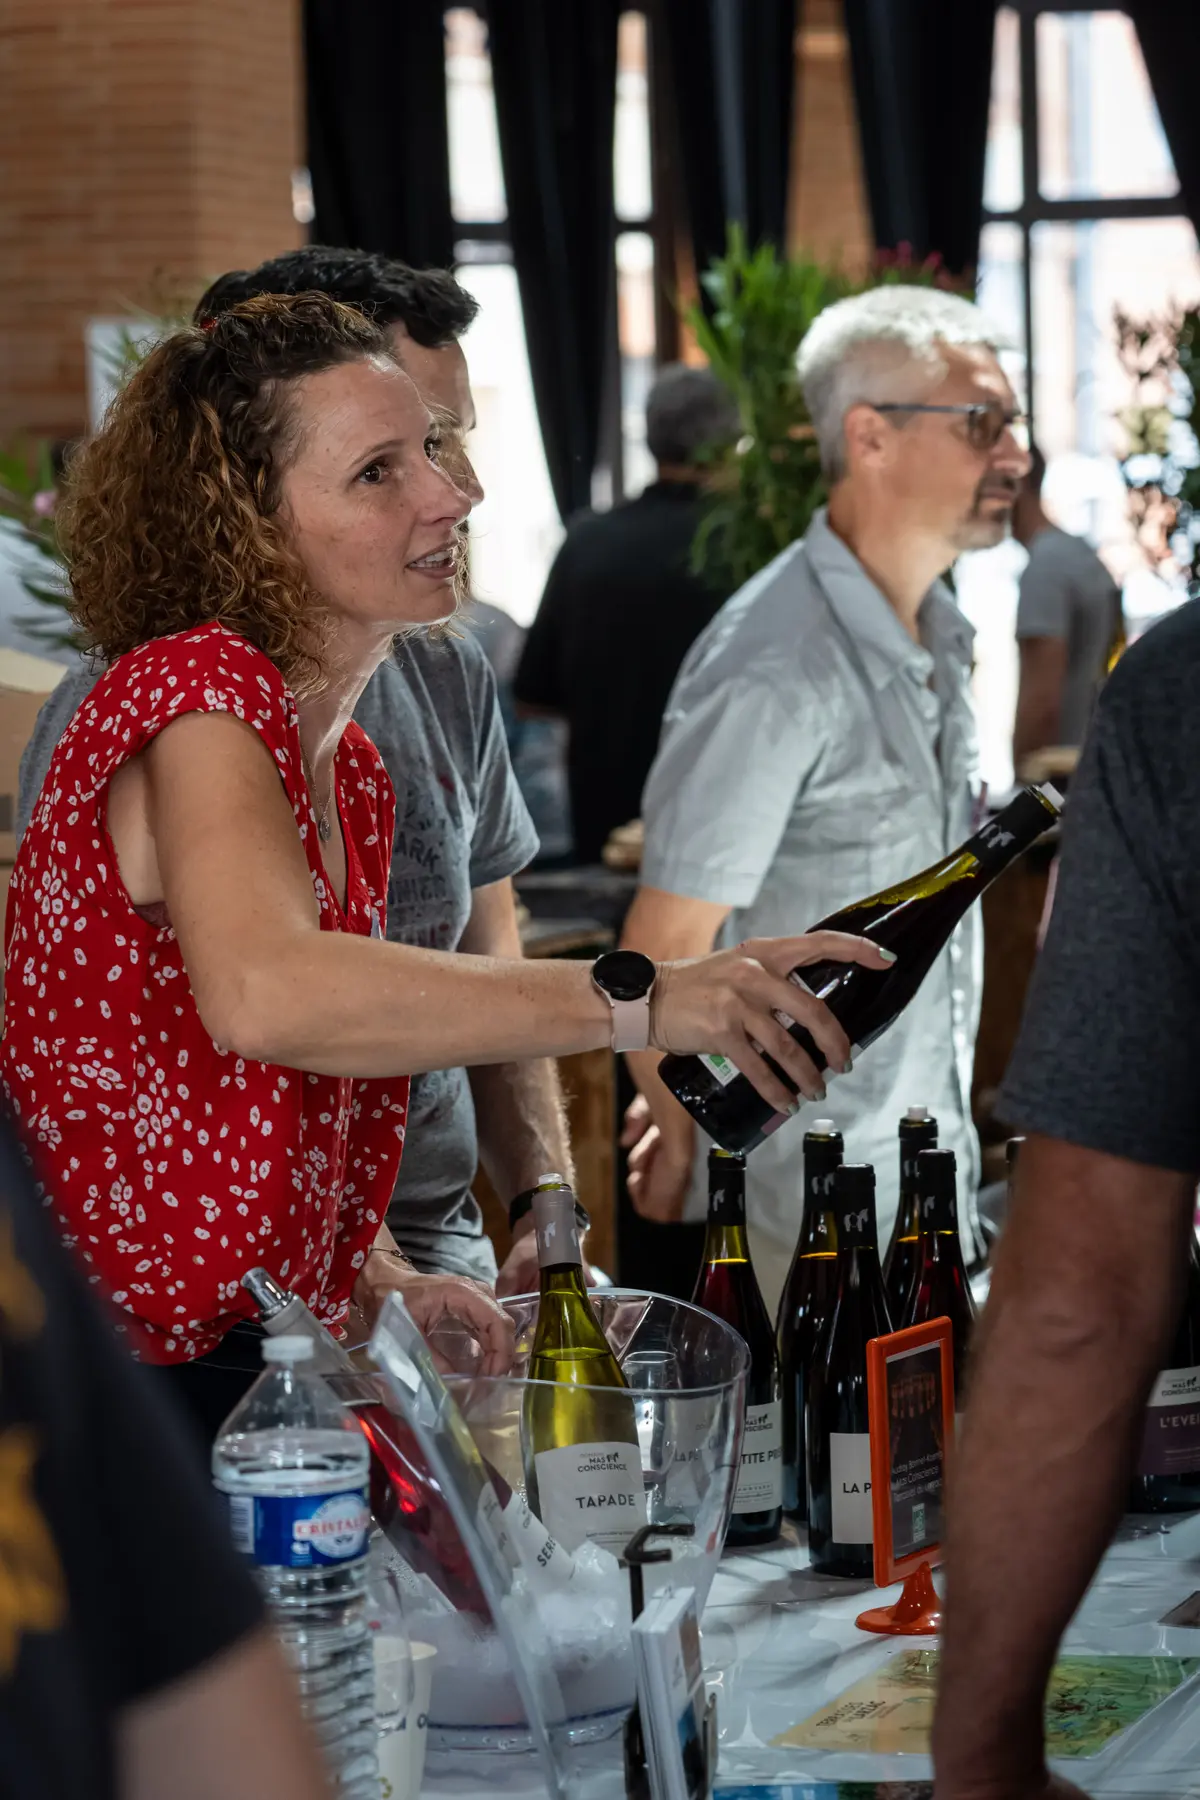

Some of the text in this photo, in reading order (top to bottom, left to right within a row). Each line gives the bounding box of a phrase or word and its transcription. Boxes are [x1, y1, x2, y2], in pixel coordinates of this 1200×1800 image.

[589, 1456, 606, 1464] MAS
[577, 1463, 627, 1472] CONSCIENCE
[843, 1482, 860, 1494] LA
[575, 1494, 636, 1509] TAPADE
